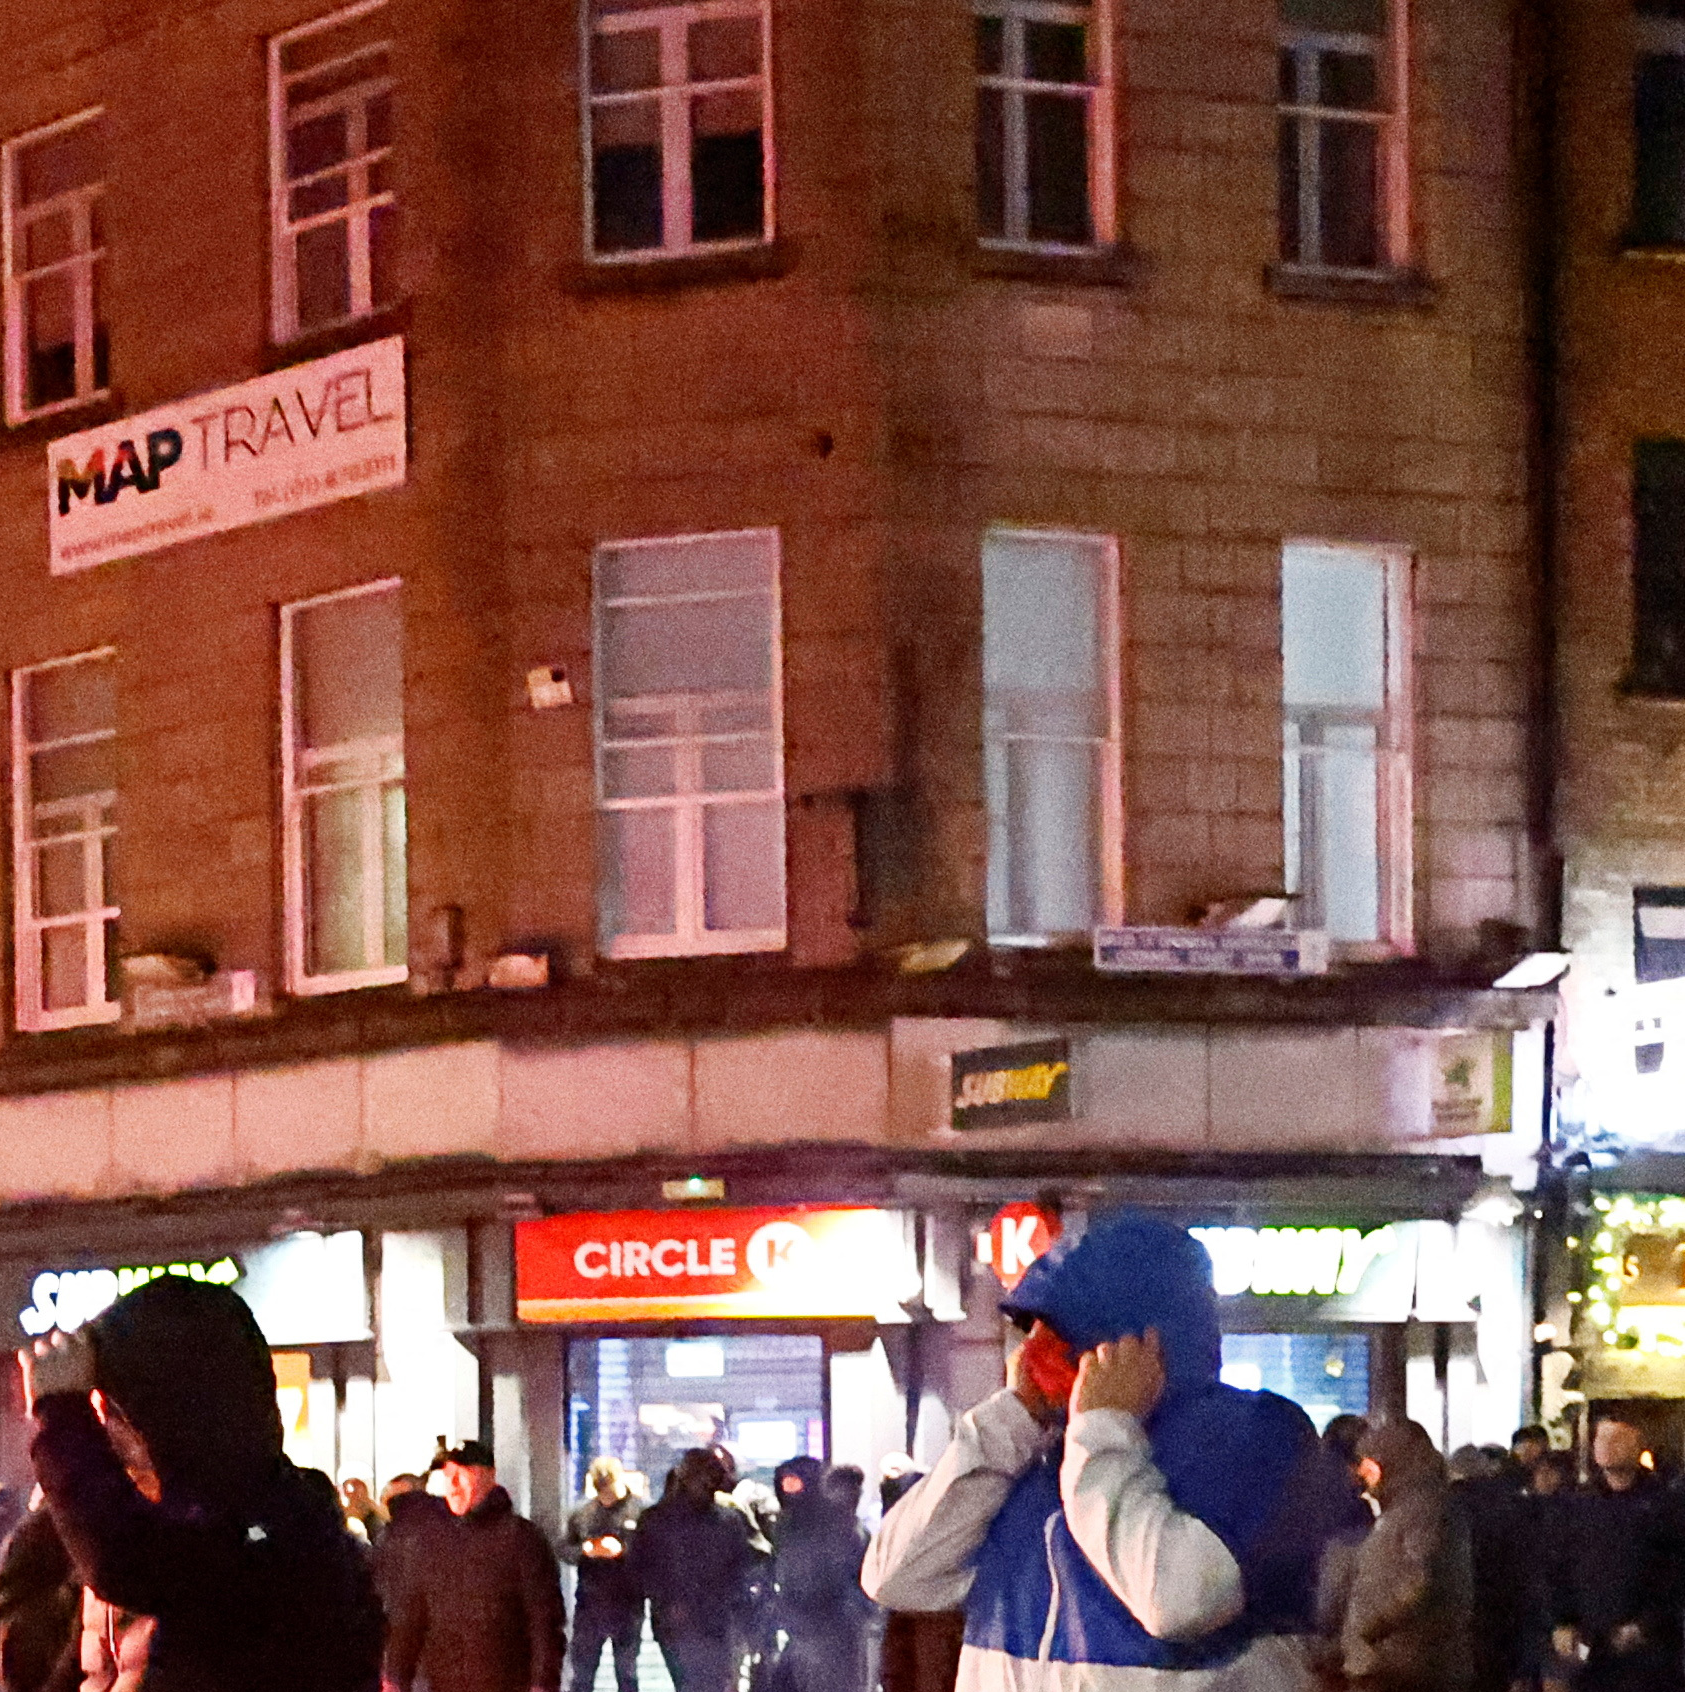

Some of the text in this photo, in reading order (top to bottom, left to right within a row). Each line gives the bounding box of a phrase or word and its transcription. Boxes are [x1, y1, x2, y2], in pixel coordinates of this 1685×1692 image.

[57, 427, 183, 516] MAP
[191, 368, 394, 470] TRAVEL
[955, 1061, 1070, 1109] SUBWAY
[574, 1237, 794, 1279] CIRCLE K
[1001, 1216, 1037, 1274] K
